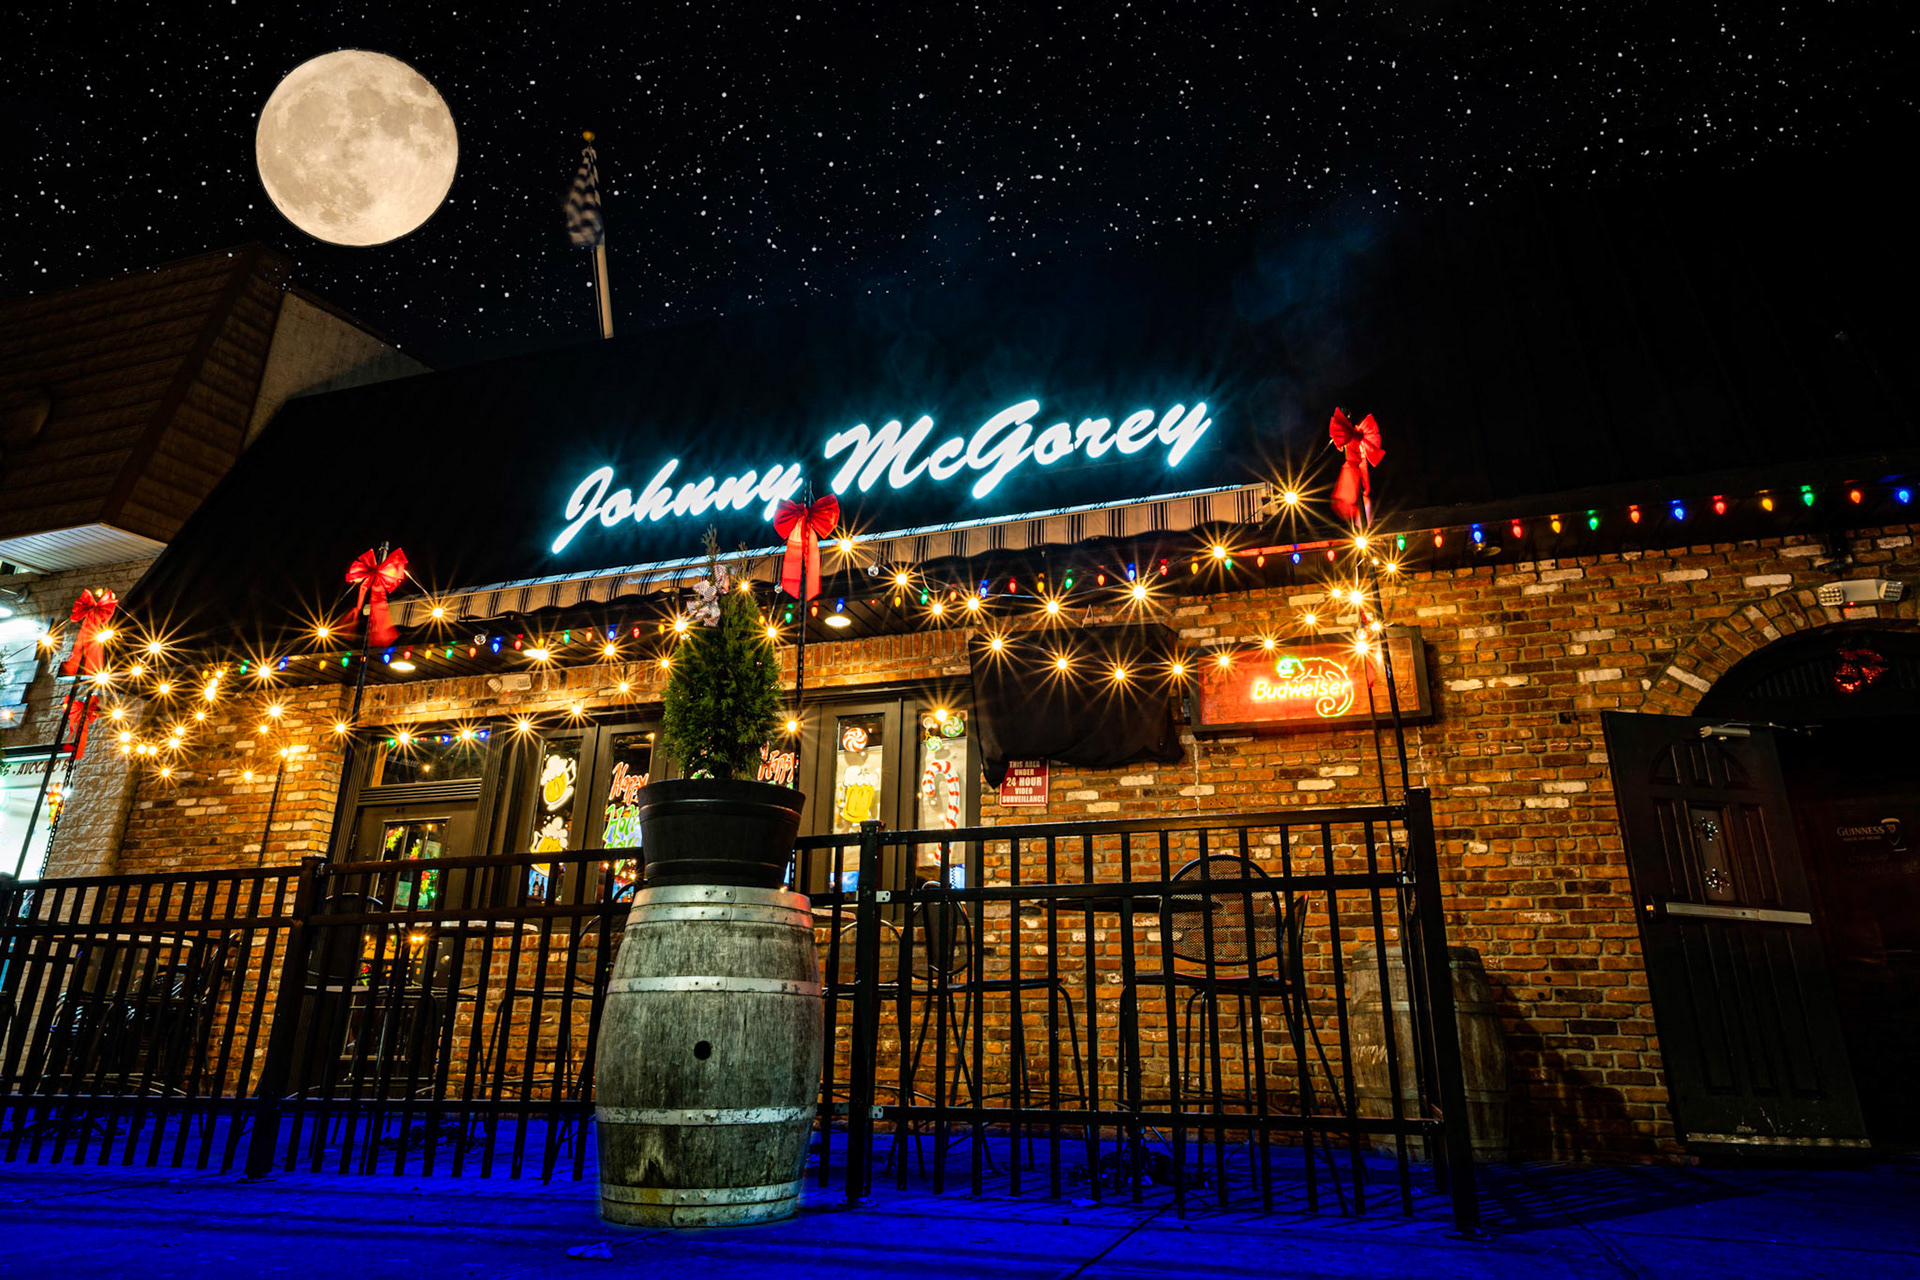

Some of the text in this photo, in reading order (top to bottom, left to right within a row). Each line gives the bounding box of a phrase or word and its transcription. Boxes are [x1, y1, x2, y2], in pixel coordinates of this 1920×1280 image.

[552, 400, 1212, 554] Johnny McGorey
[1254, 678, 1352, 702] Budweiser
[16, 759, 61, 776] AVOCAO
[1006, 777, 1042, 787] 24 HOUR
[1002, 795, 1044, 803] SURVEILLANCE
[1837, 825, 1885, 837] GUINNESS
